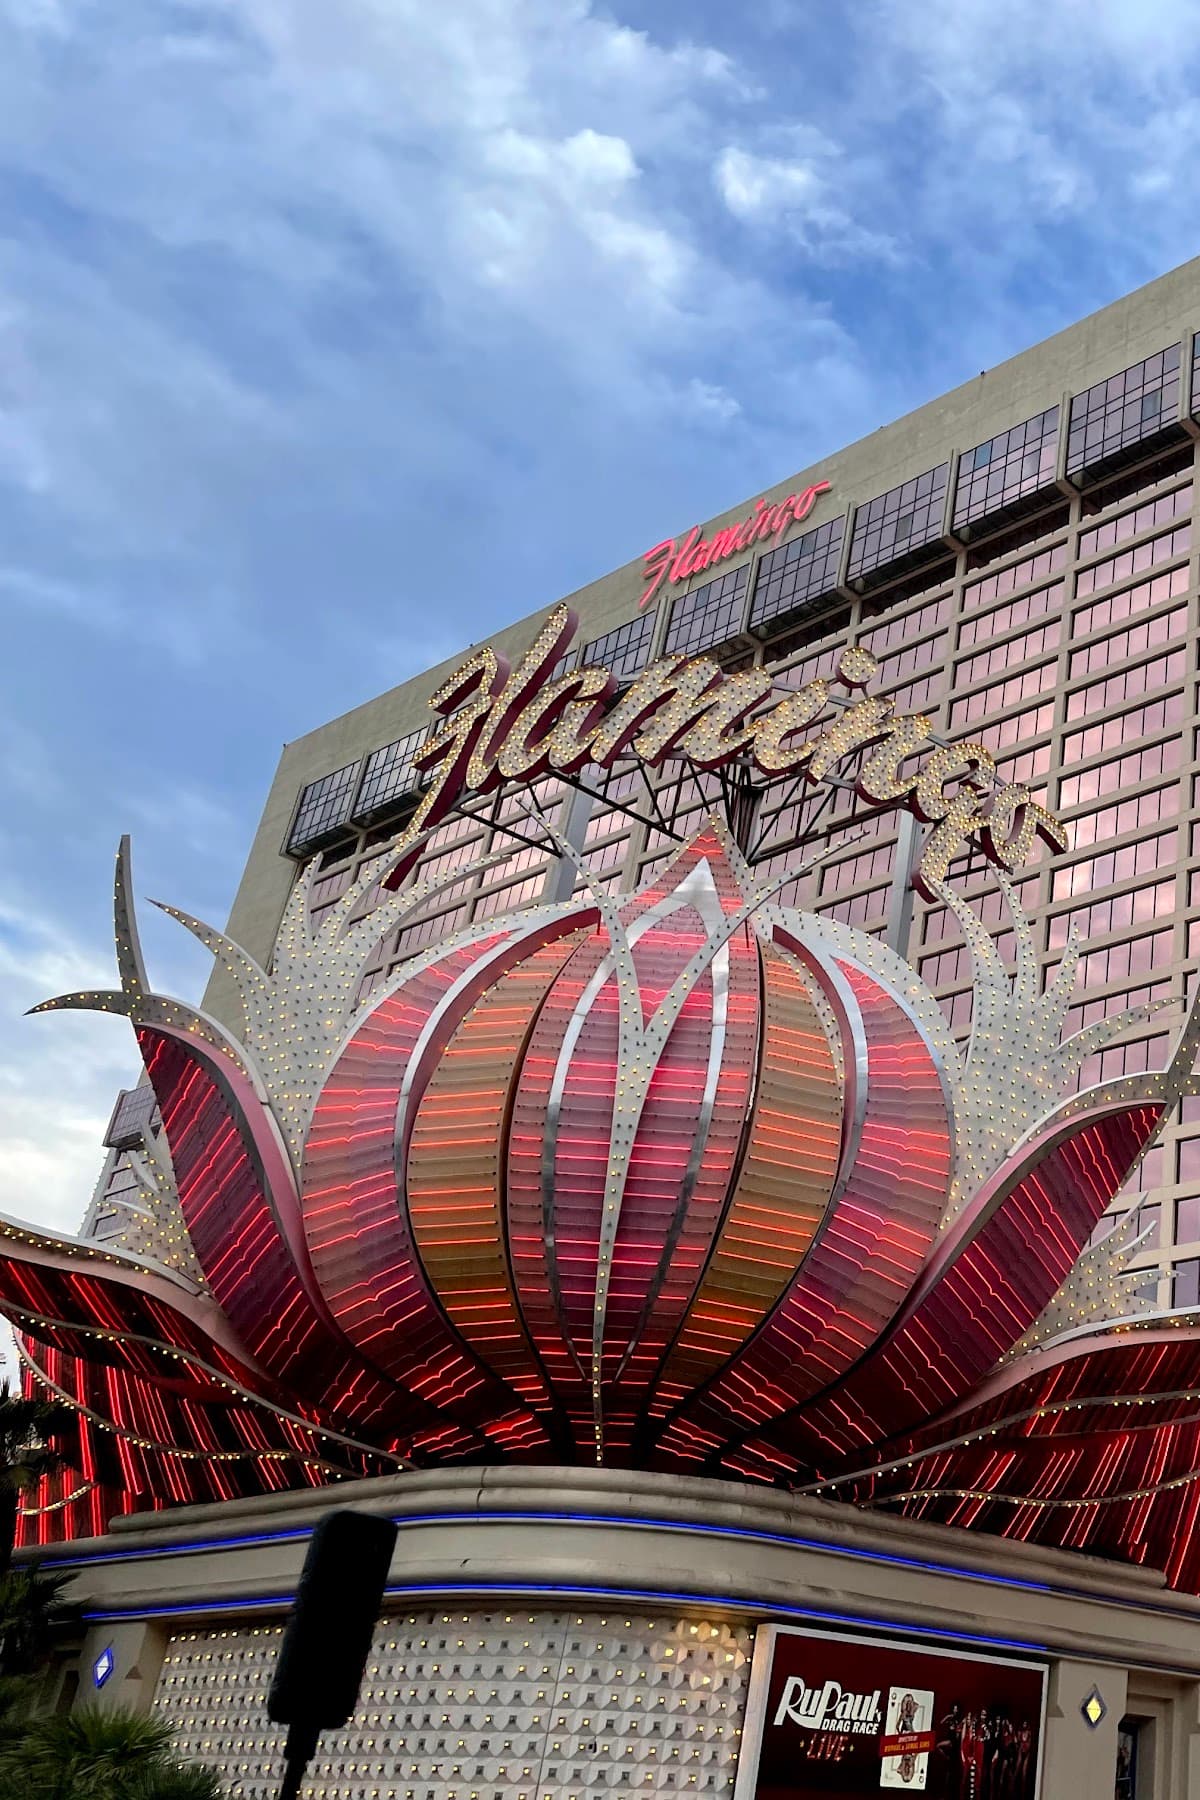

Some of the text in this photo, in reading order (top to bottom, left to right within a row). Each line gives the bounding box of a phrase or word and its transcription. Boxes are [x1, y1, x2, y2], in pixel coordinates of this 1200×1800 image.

[639, 480, 832, 612] Flamingo
[382, 602, 1070, 904] Flamingo
[773, 1676, 882, 1730] RuPaul's
[821, 1718, 880, 1735] DRAG RACE
[806, 1733, 849, 1762] LIVE
